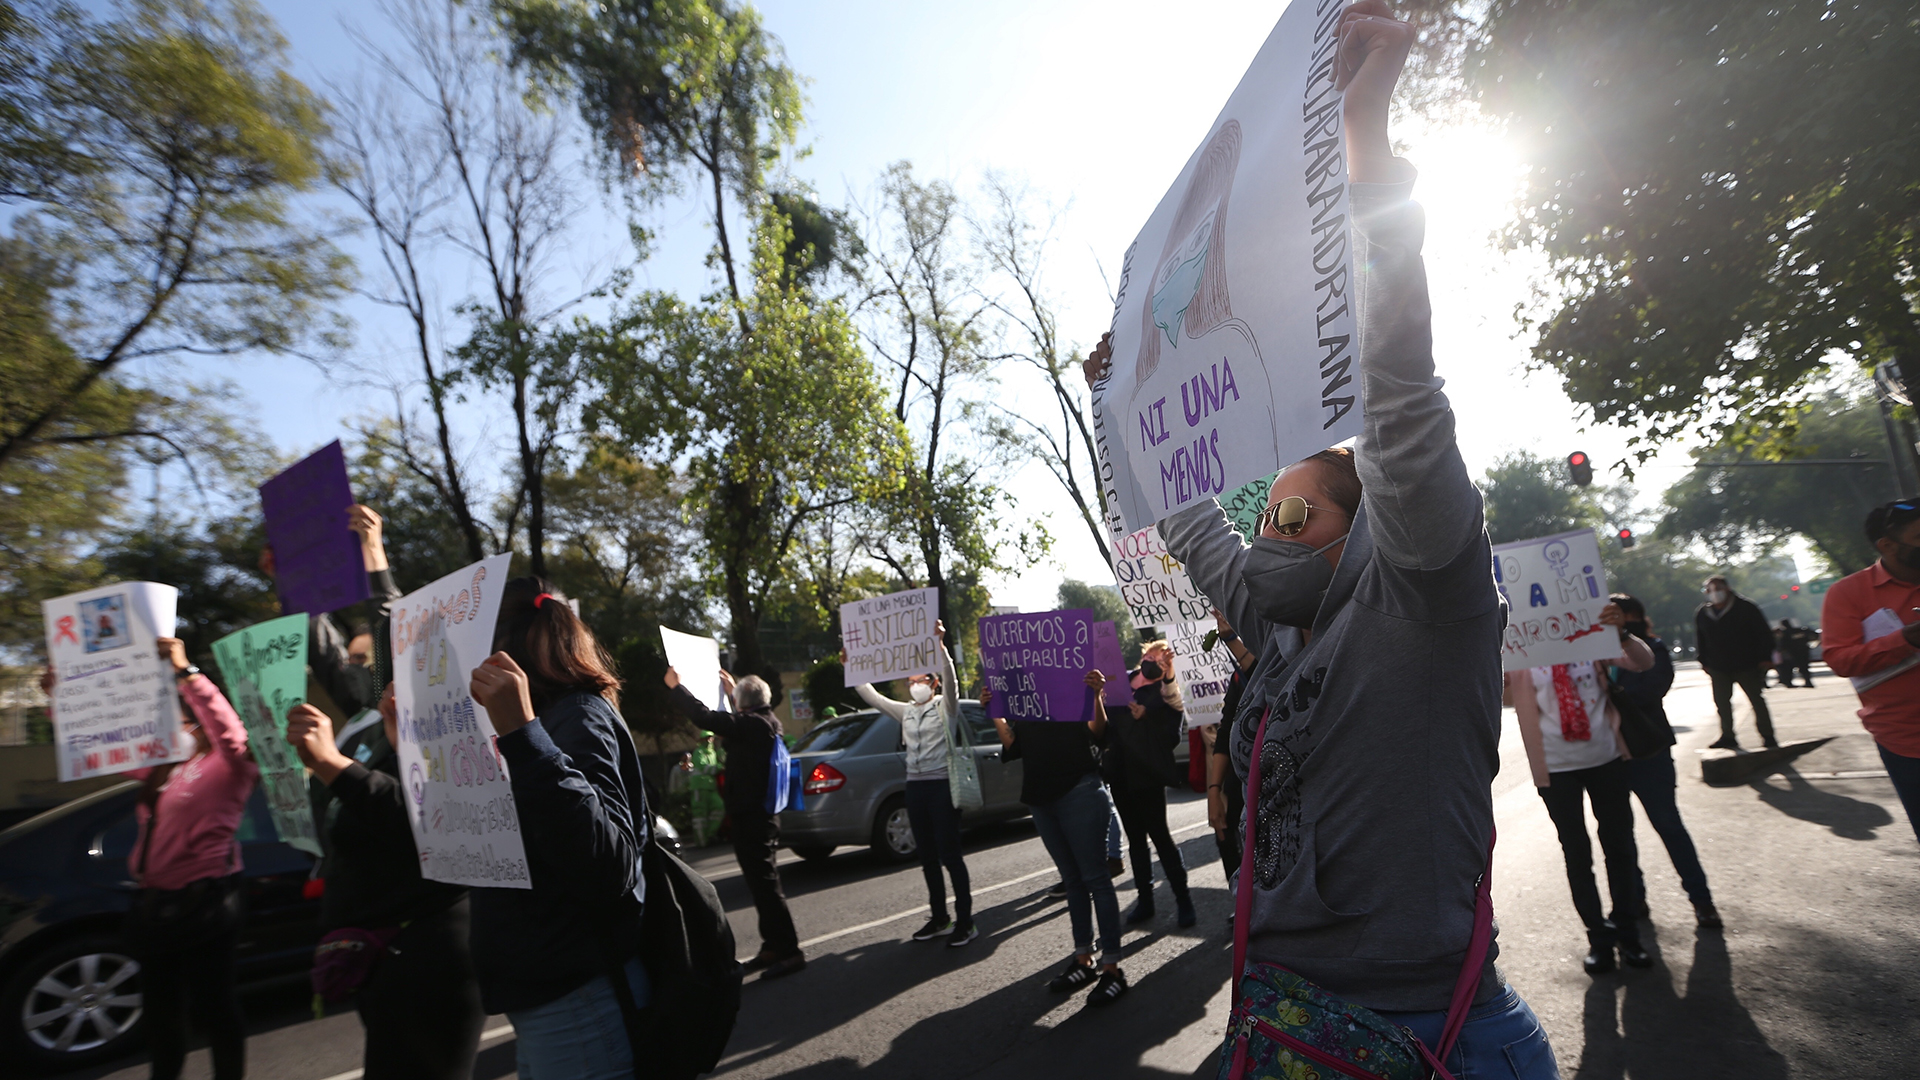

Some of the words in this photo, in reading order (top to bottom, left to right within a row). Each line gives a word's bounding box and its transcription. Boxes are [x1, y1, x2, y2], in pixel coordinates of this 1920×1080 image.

[1139, 396, 1170, 452] NI
[1181, 356, 1240, 427] UNA
[1160, 428, 1225, 510] MENOS
[1224, 479, 1267, 519] SOMOS
[1116, 556, 1153, 583] QUE
[874, 599, 891, 612] UNA
[893, 591, 927, 609] MENOS!
[1121, 577, 1178, 607] ESTAN
[1530, 582, 1549, 608] A
[1131, 602, 1173, 626] PARA
[845, 607, 927, 650] #JUSTICIA
[985, 616, 1065, 648] QUEREMOS
[1176, 619, 1197, 637] NO
[1002, 646, 1085, 670] CULPABLES
[1181, 667, 1204, 681] NOS
[1211, 660, 1233, 677] FAL
[988, 675, 1009, 692] TRAS
[1017, 672, 1036, 692] LAS
[1008, 692, 1050, 721] REJAS!
